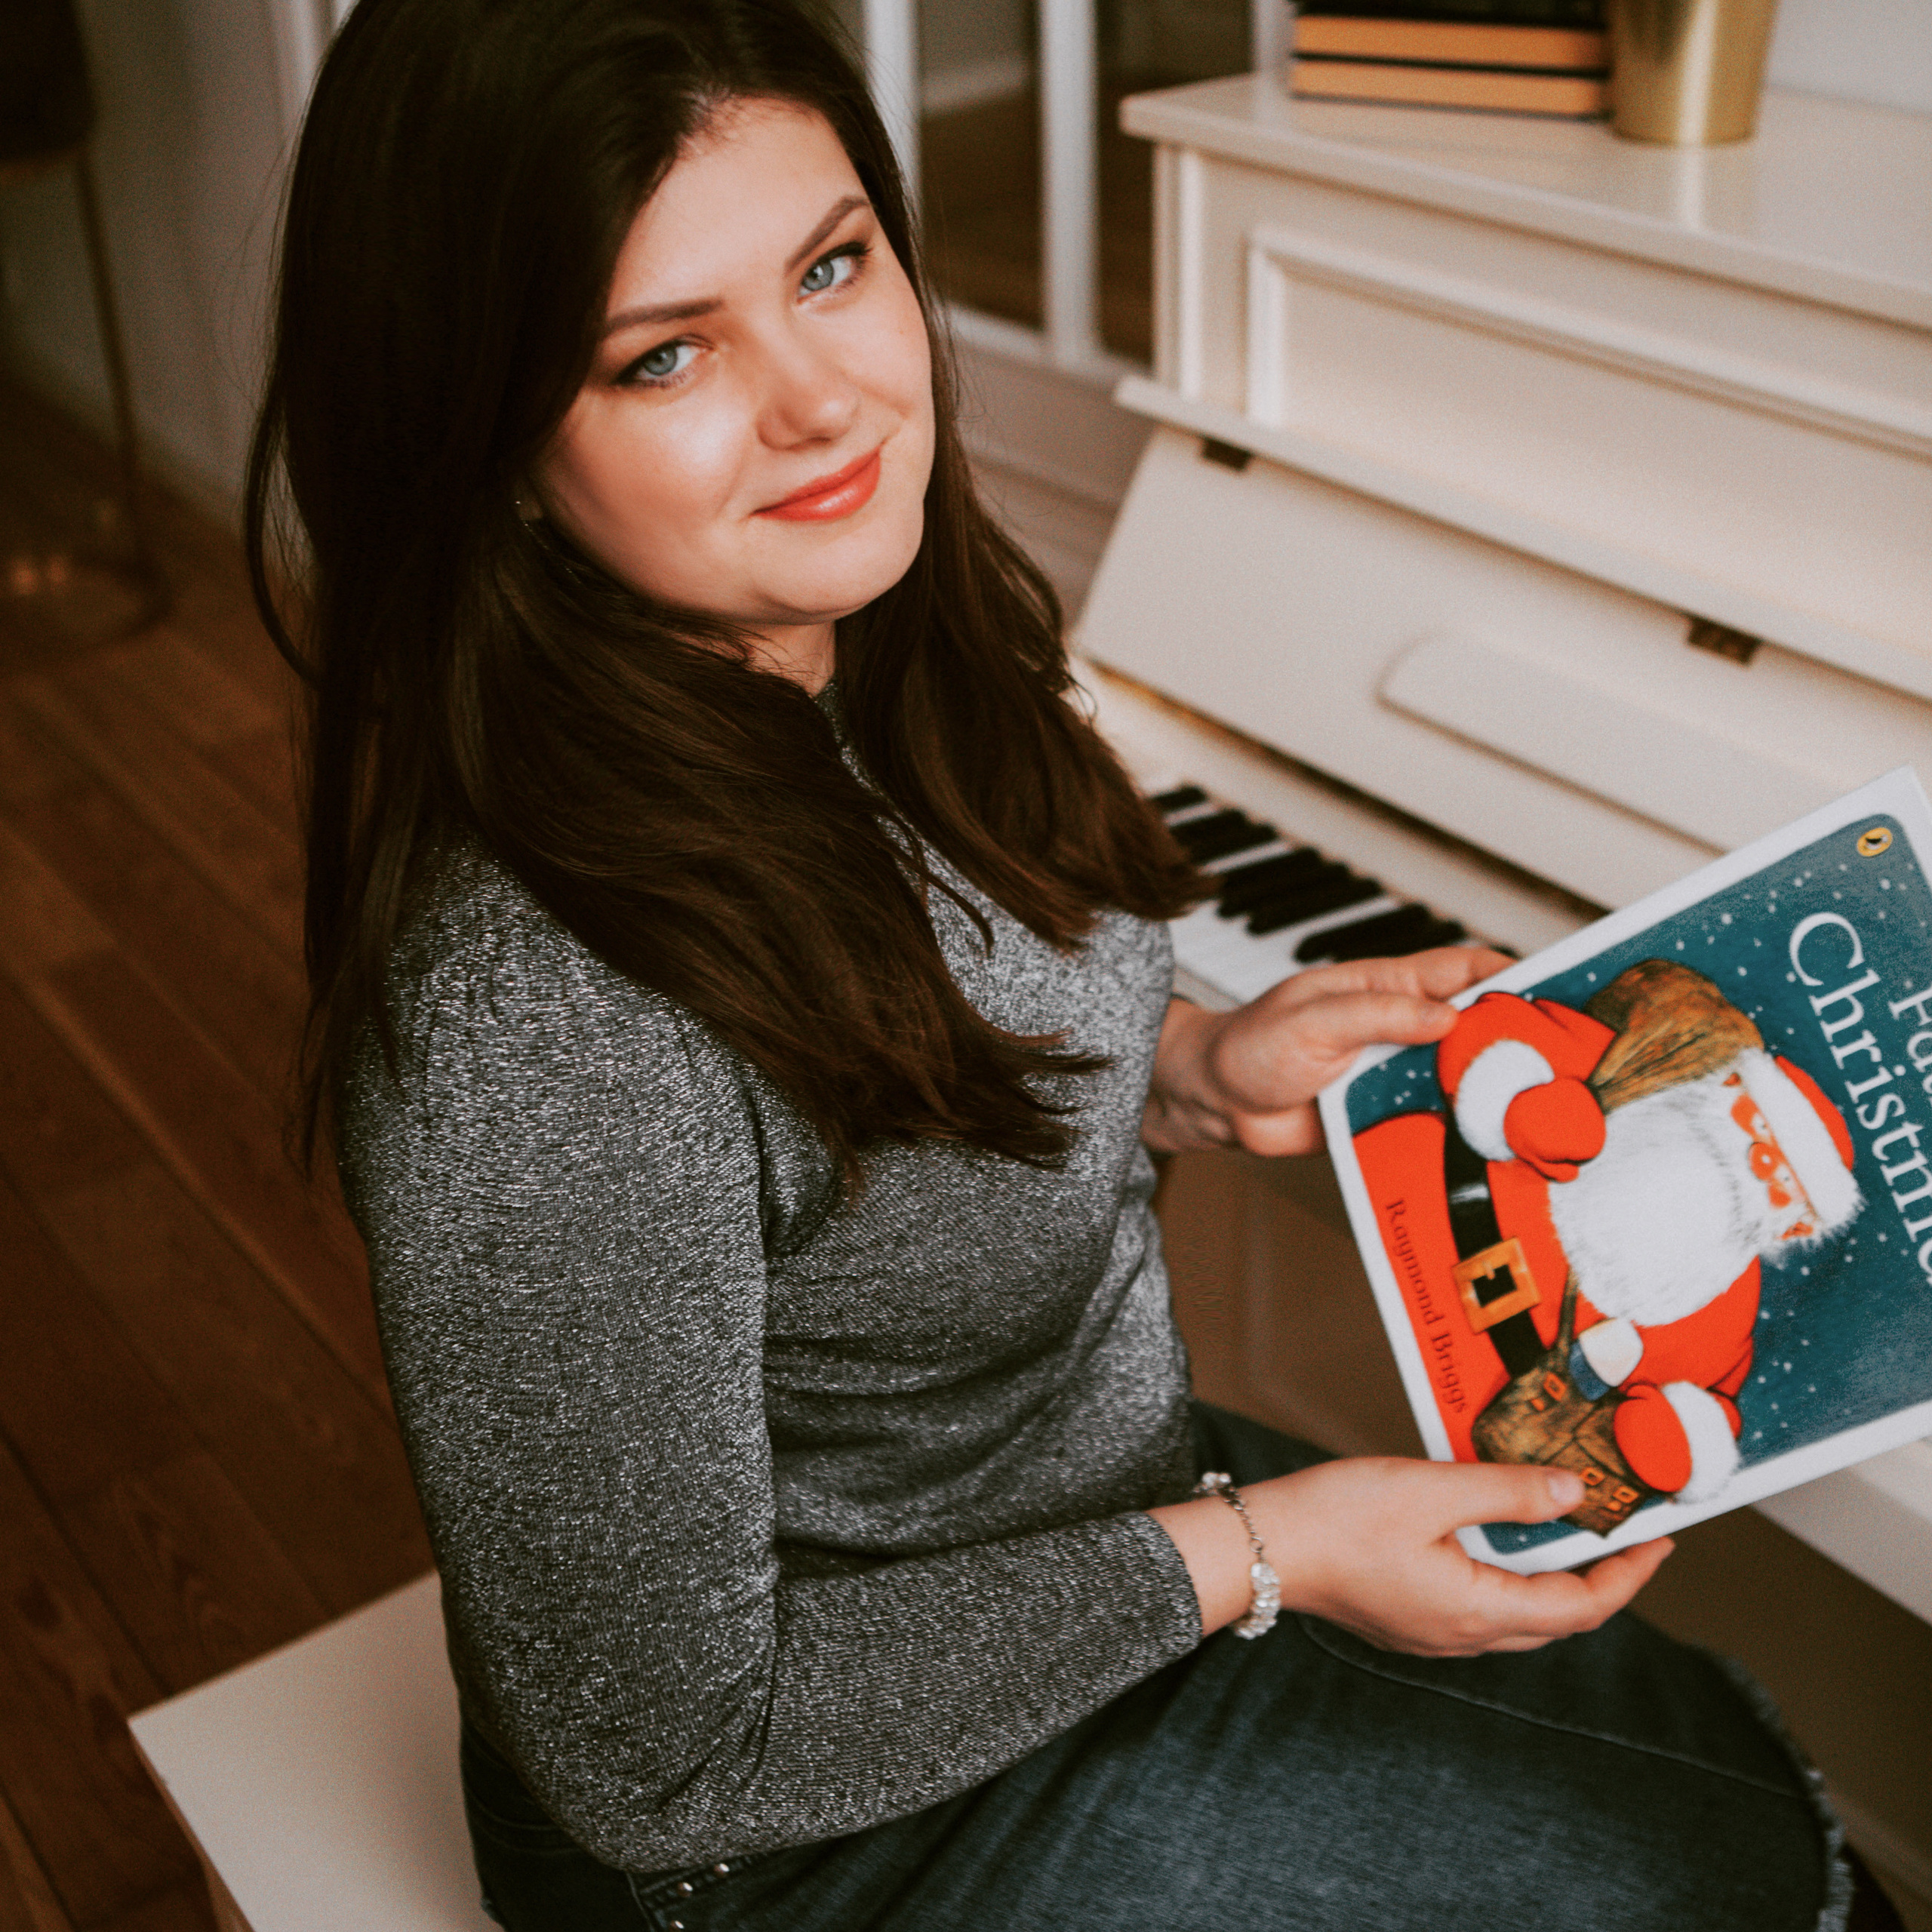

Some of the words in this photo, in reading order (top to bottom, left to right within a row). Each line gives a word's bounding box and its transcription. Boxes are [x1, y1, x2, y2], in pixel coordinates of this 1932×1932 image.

[1888, 983, 1932, 1109] Fa
[1386, 1199, 1445, 1325] Raymond
[1432, 1332, 1467, 1414] Briggs
